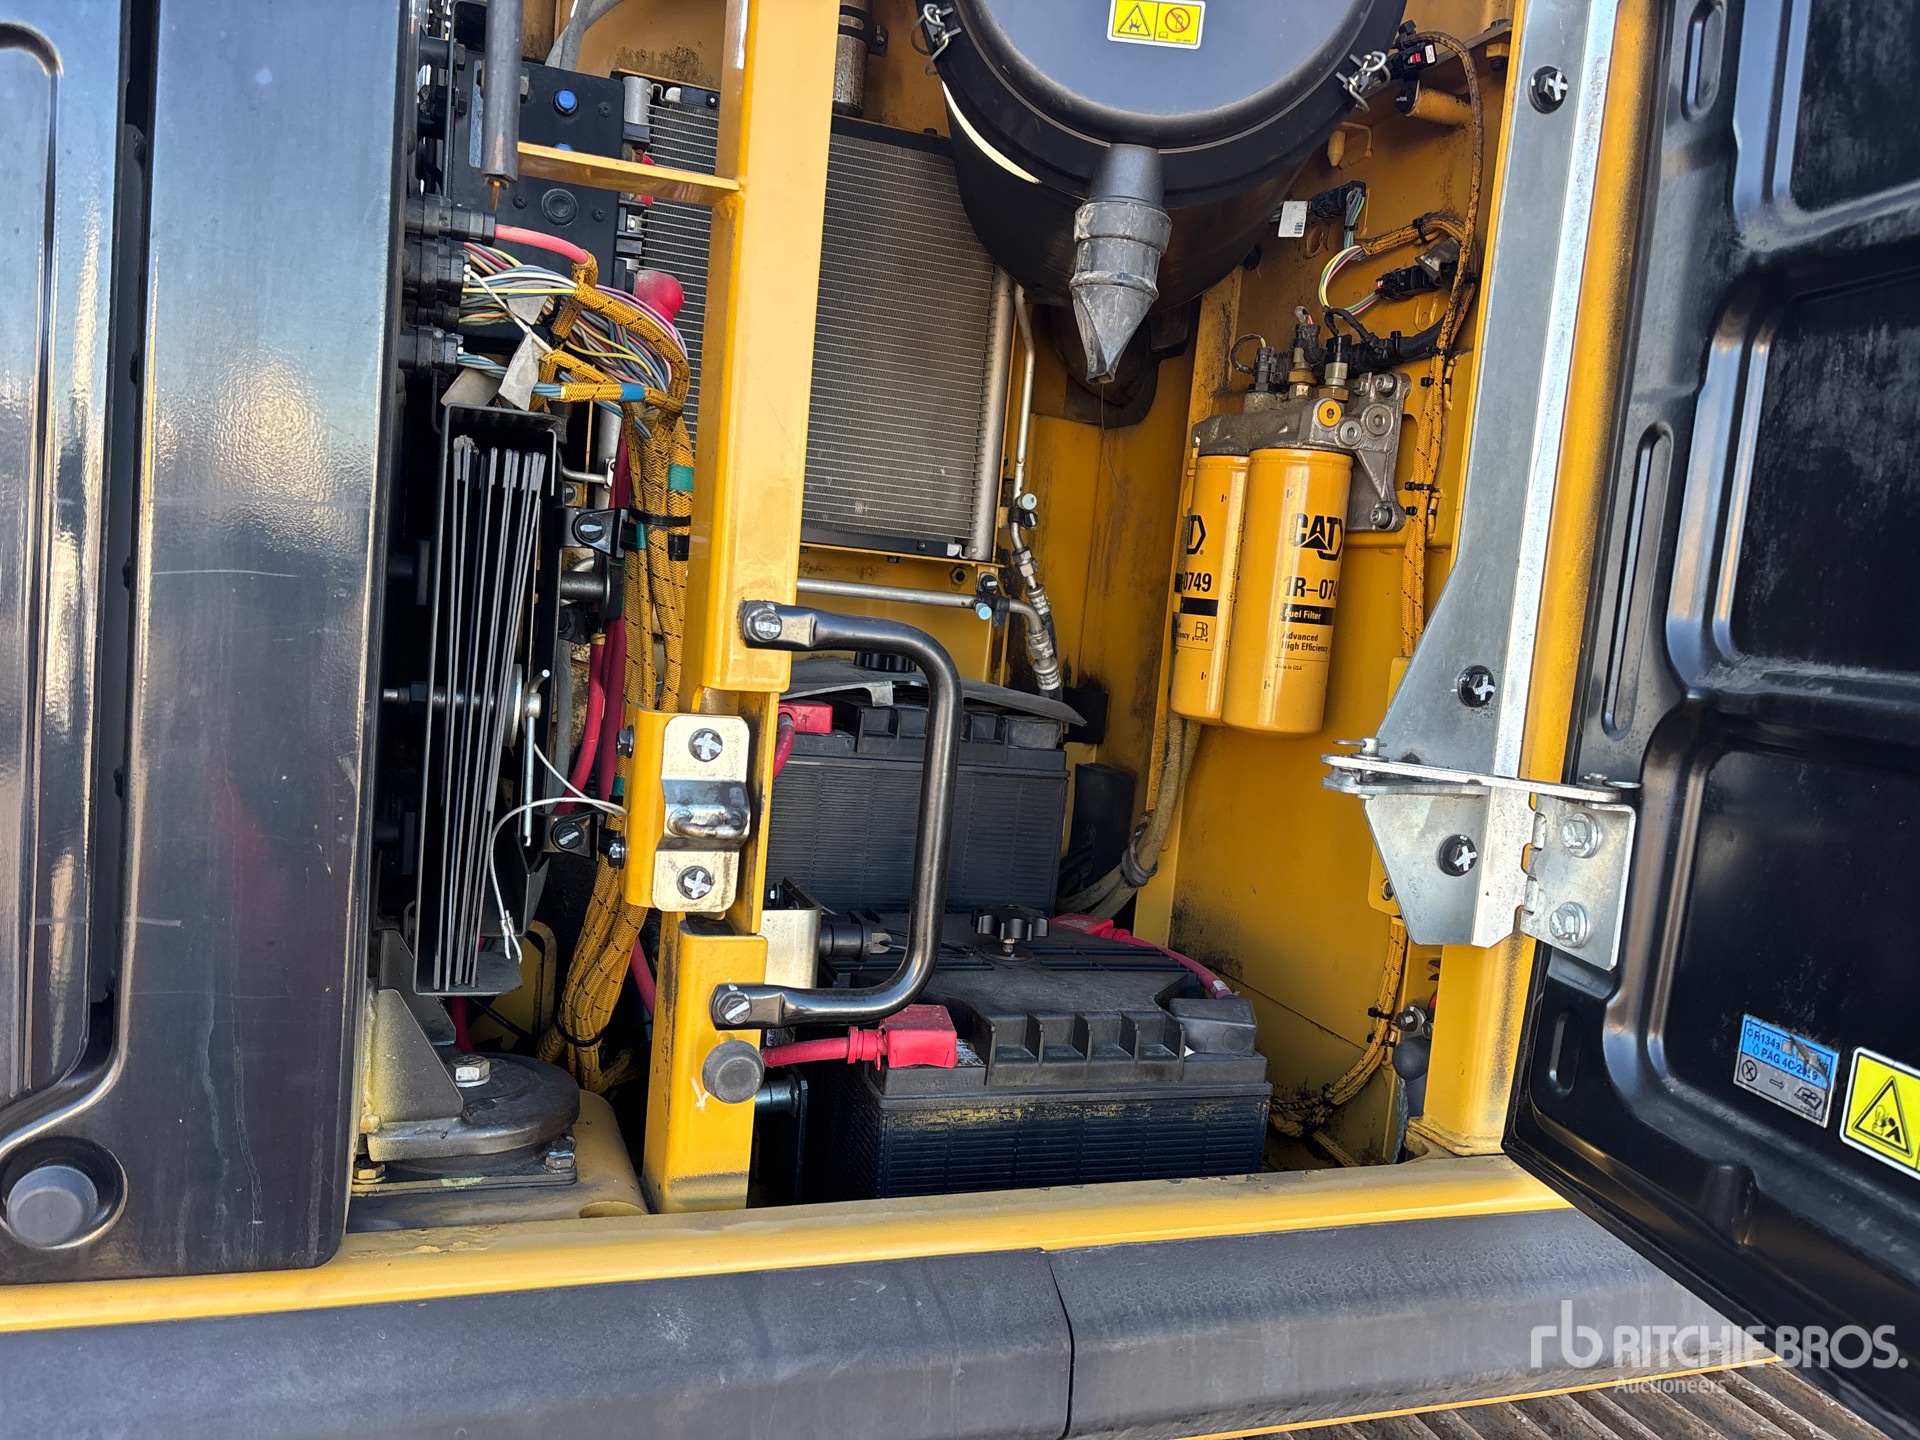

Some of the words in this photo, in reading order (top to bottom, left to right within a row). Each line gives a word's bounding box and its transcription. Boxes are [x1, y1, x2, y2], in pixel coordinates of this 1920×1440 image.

[1289, 512, 1340, 551] CAT
[1284, 608, 1302, 618] Fuel
[1303, 610, 1322, 620] Filter
[1281, 630, 1319, 642] Advanced
[1281, 641, 1300, 651] High
[1301, 642, 1329, 654] Efficiency
[1754, 1031, 1781, 1050] R134a
[1761, 1048, 1780, 1064] PAG
